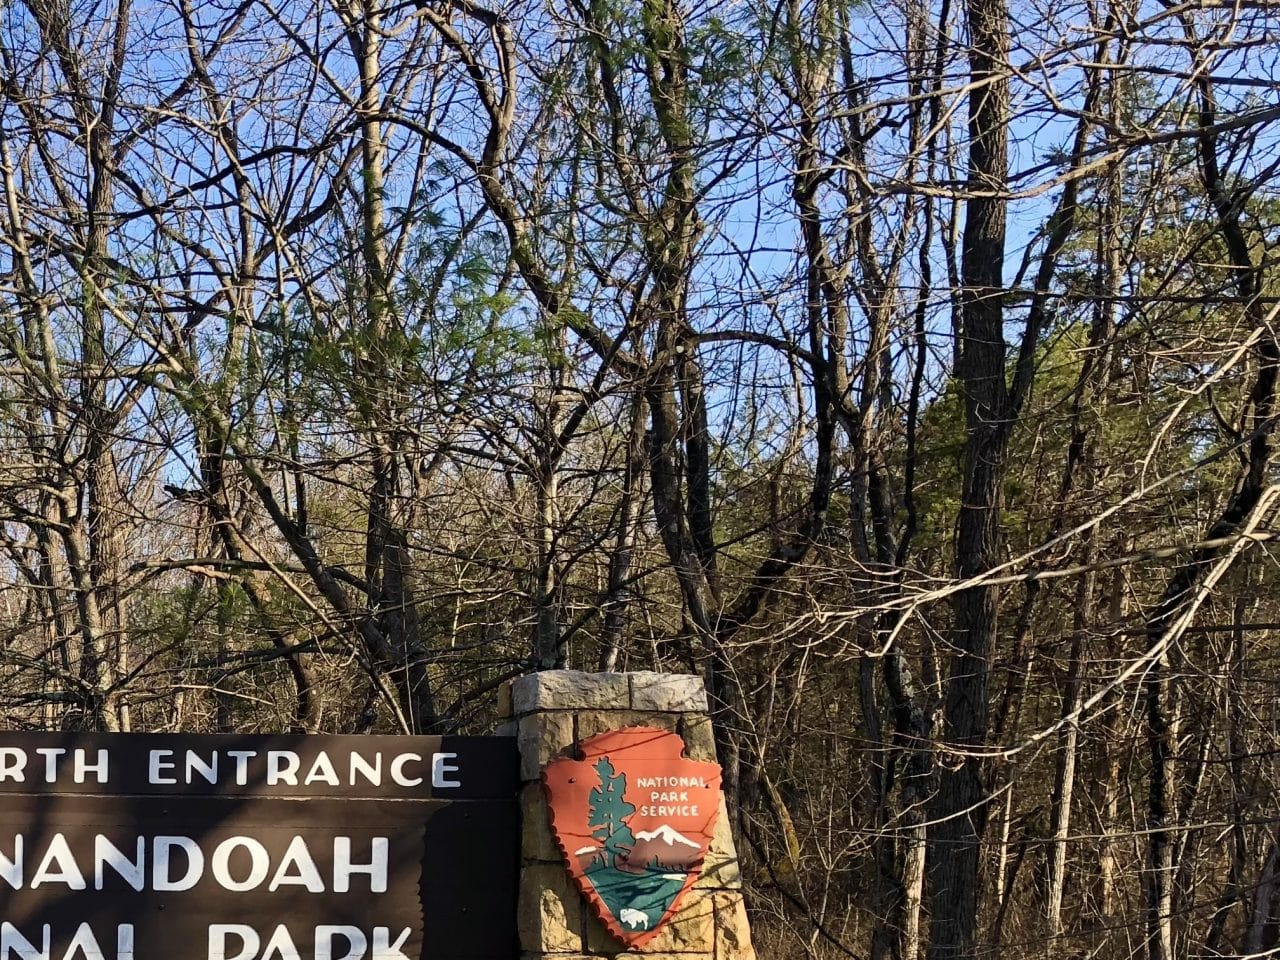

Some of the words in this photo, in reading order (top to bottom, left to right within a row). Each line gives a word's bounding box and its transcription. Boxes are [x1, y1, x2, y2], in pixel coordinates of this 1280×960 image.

[148, 749, 461, 788] ENTRANCE
[637, 776, 706, 788] NATIONAL
[651, 791, 689, 802] PARK
[640, 805, 700, 817] SERVICE
